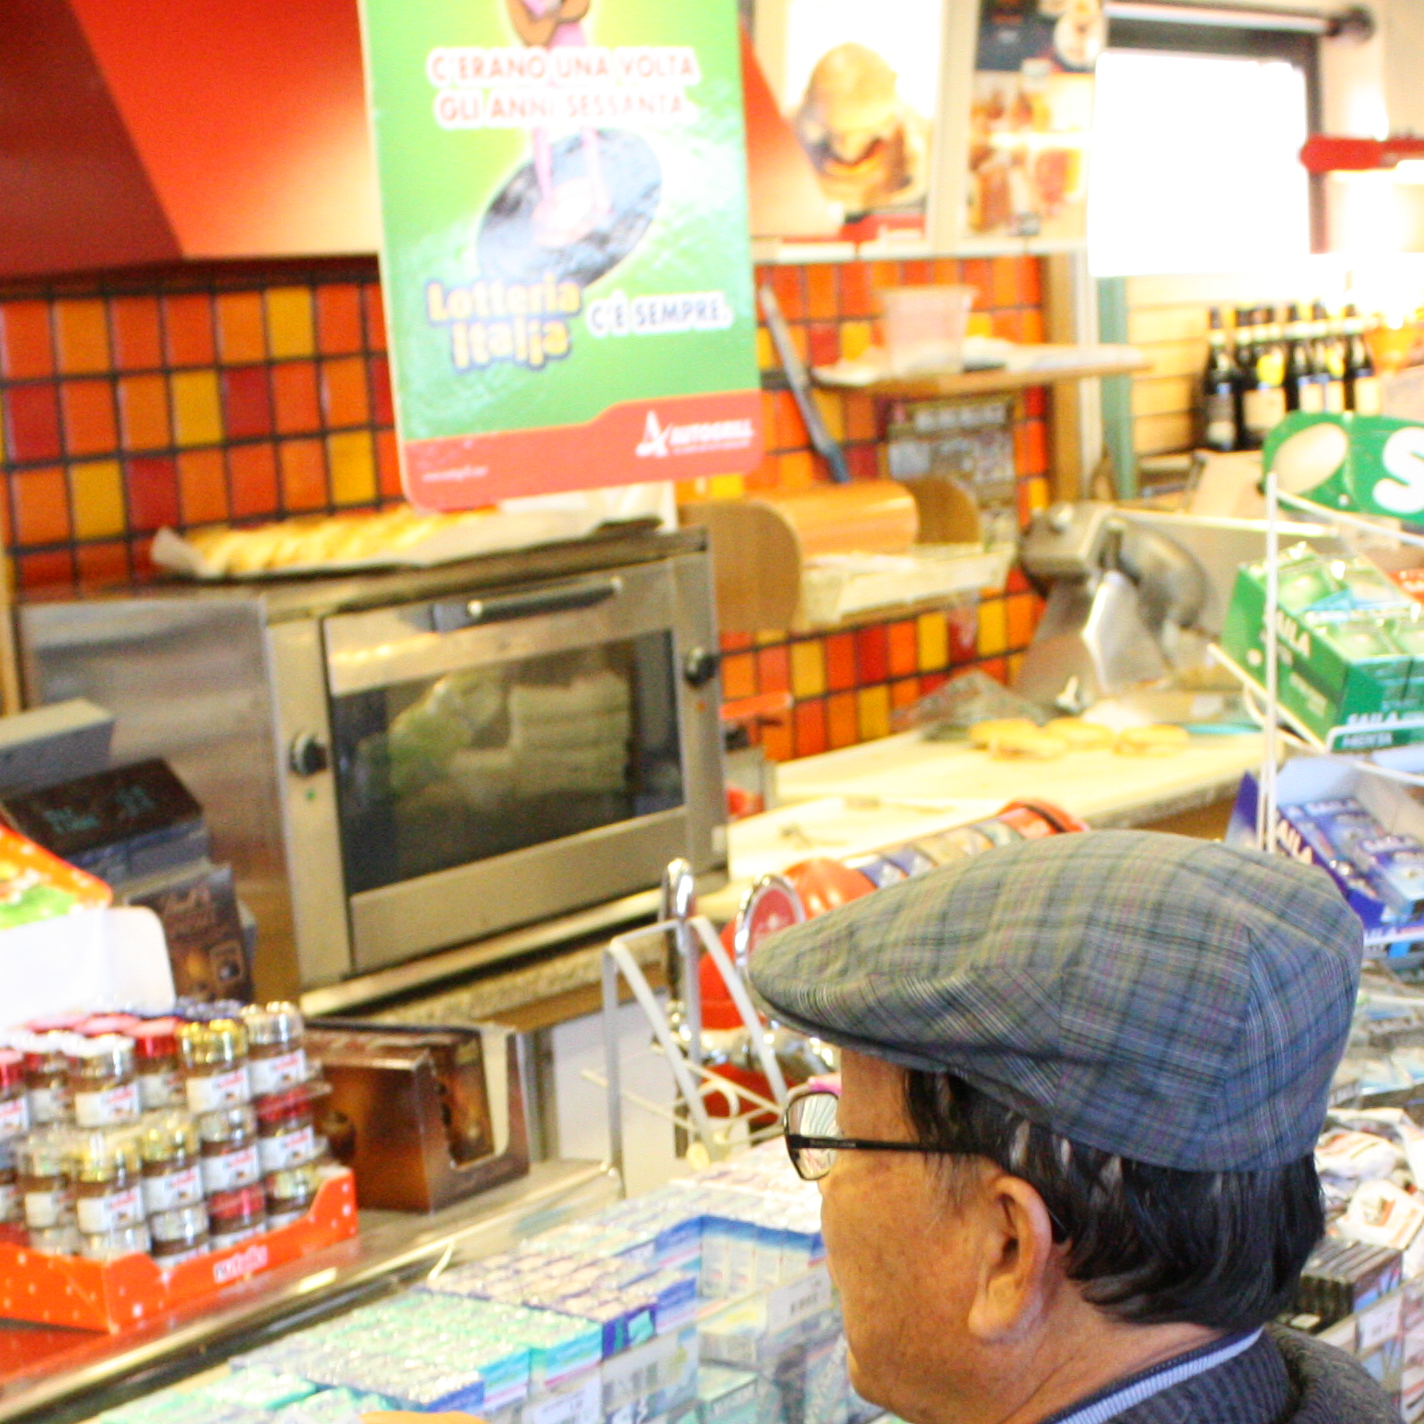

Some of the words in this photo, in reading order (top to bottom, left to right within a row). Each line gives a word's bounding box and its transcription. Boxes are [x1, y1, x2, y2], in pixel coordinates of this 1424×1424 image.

[430, 55, 547, 81] C'ERANO
[556, 54, 610, 79] UNA
[620, 53, 696, 78] VOLTA
[439, 96, 480, 122] GLI
[490, 94, 557, 119] ANNI
[426, 272, 582, 322] Lotteria
